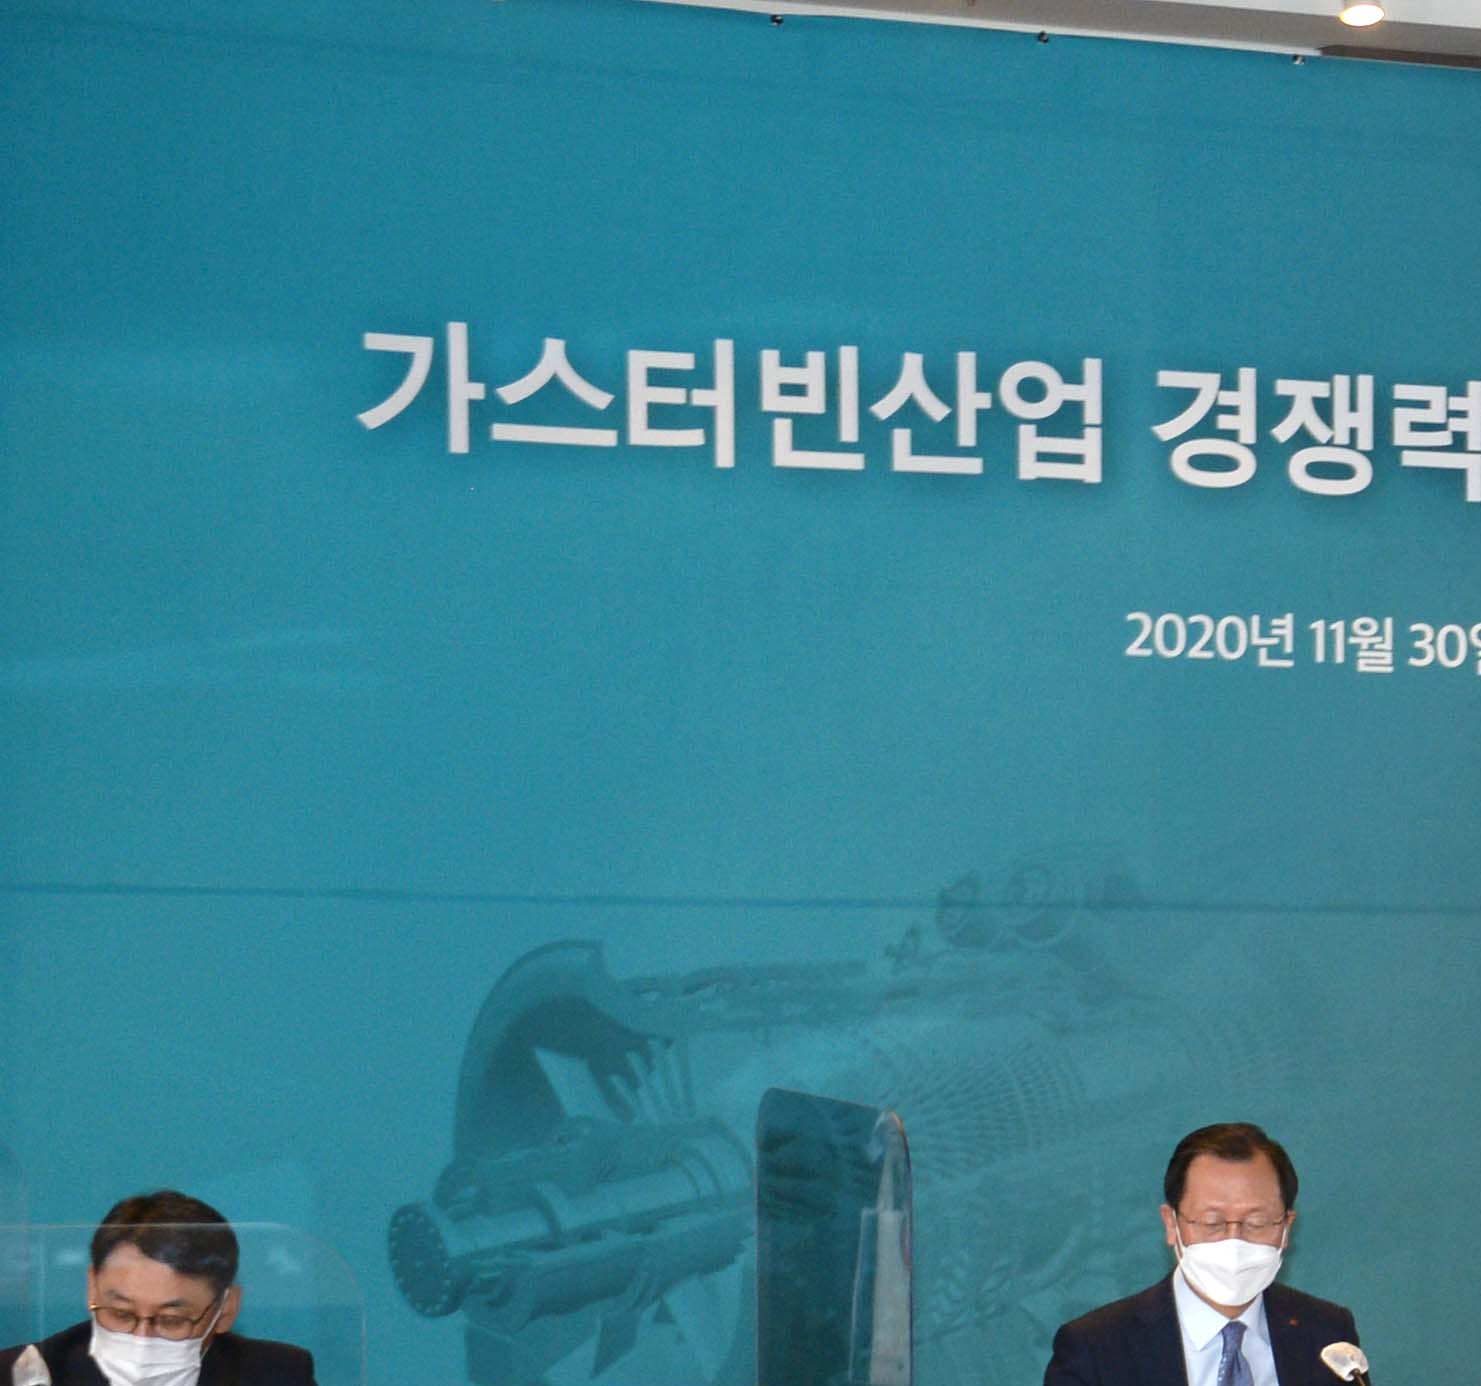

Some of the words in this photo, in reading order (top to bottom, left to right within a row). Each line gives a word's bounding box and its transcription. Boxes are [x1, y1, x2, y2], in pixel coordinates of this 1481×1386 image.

[357, 322, 1101, 483] 가스터빈산업
[1125, 612, 1294, 667] 2020년
[1310, 617, 1394, 673] 11월
